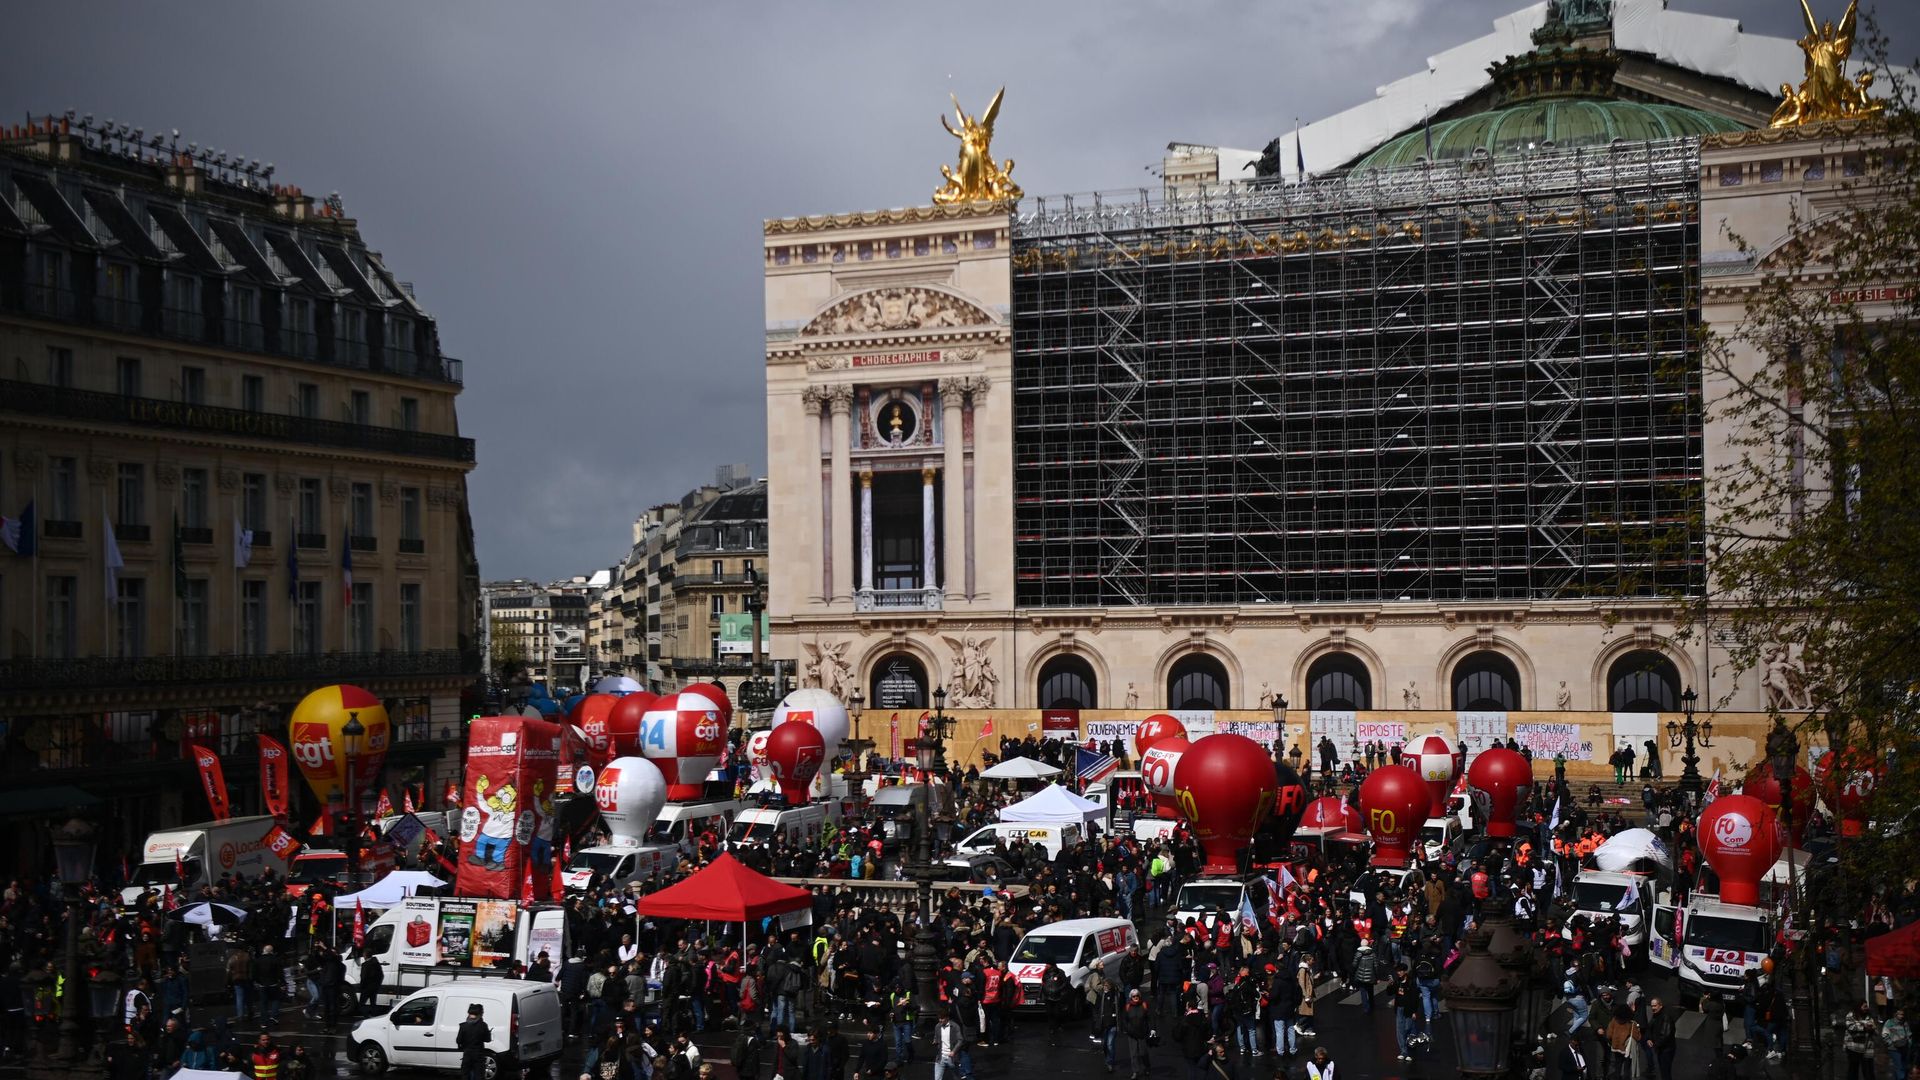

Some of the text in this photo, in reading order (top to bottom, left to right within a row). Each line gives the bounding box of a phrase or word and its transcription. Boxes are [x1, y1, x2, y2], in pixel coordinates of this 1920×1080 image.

[861, 352, 932, 365] CHOREGRAPHIE
[584, 720, 606, 736] cgt
[694, 722, 720, 741] cgt
[1358, 724, 1404, 737] RIPOSTE
[294, 737, 336, 768] cgt
[595, 782, 619, 808] cgt
[1279, 784, 1305, 816] FO
[1371, 807, 1396, 834] FO
[1716, 818, 1736, 835] FO
[271, 831, 292, 852] cgt
[1009, 830, 1048, 838] FLY CAR
[1711, 948, 1740, 963] FO
[1022, 965, 1046, 975] FO
[1709, 963, 1740, 976] FO Com
